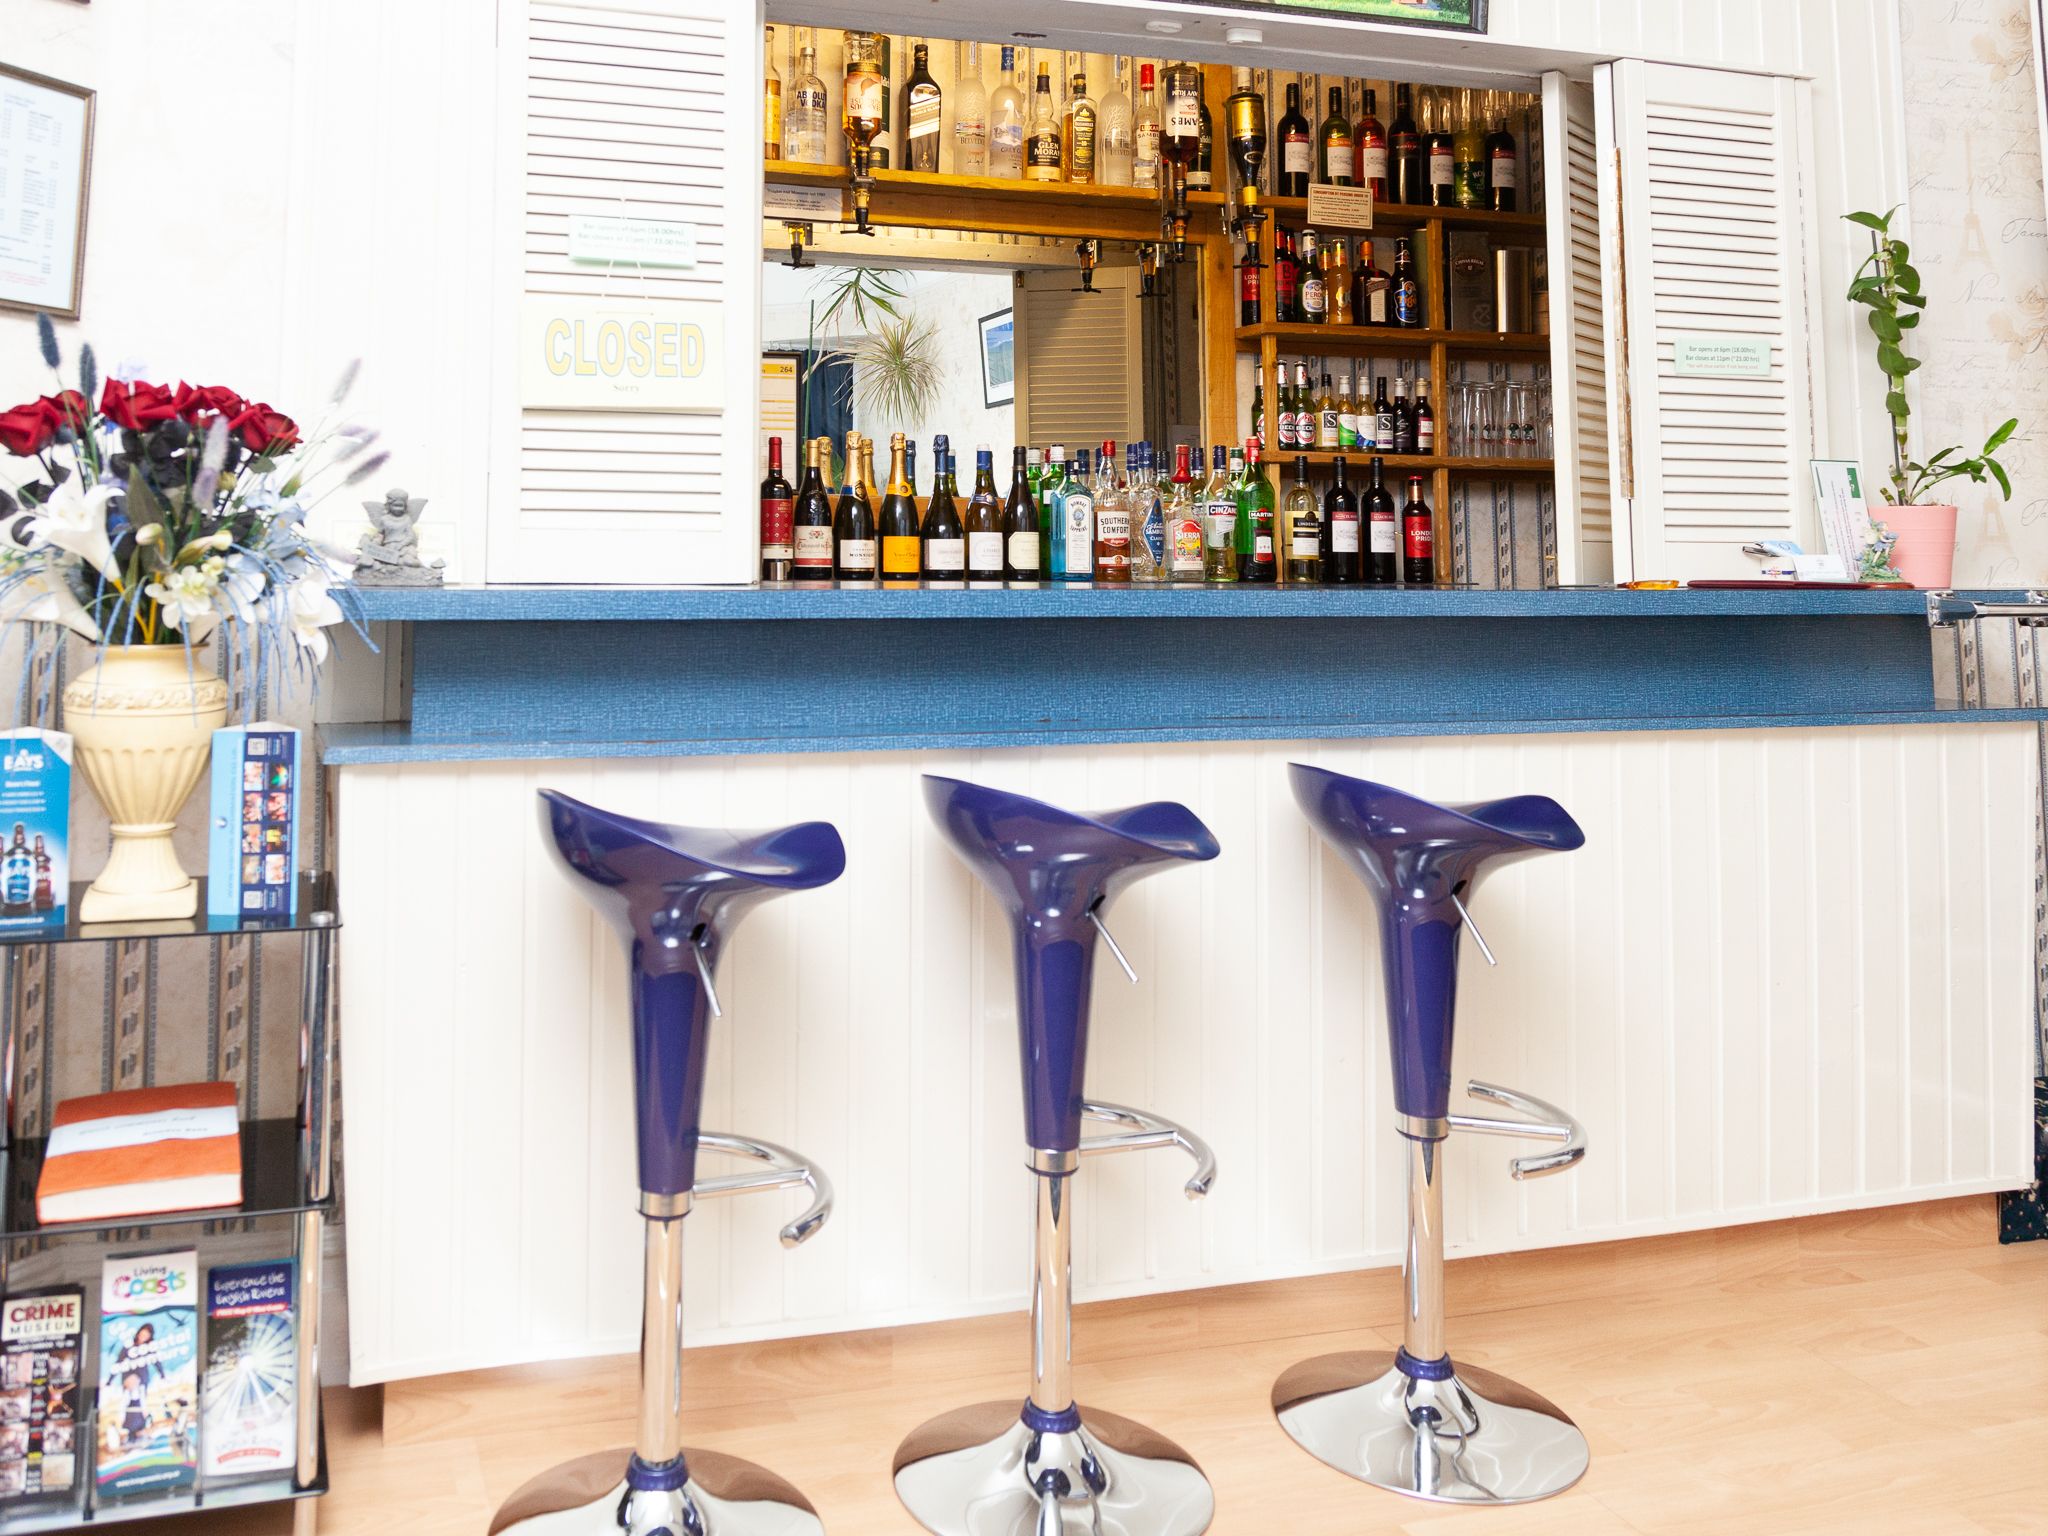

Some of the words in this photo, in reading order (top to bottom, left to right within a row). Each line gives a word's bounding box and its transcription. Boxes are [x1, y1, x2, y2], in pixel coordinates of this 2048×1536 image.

[797, 91, 827, 101] ABOLU
[800, 100, 826, 108] VDKA
[1037, 142, 1059, 150] GLEN
[544, 318, 705, 379] CLOSED
[1210, 506, 1237, 515] CINZAN
[132, 1267, 166, 1278] Living
[10, 1303, 76, 1322] CRIME
[10, 1321, 75, 1335] MUSEUM
